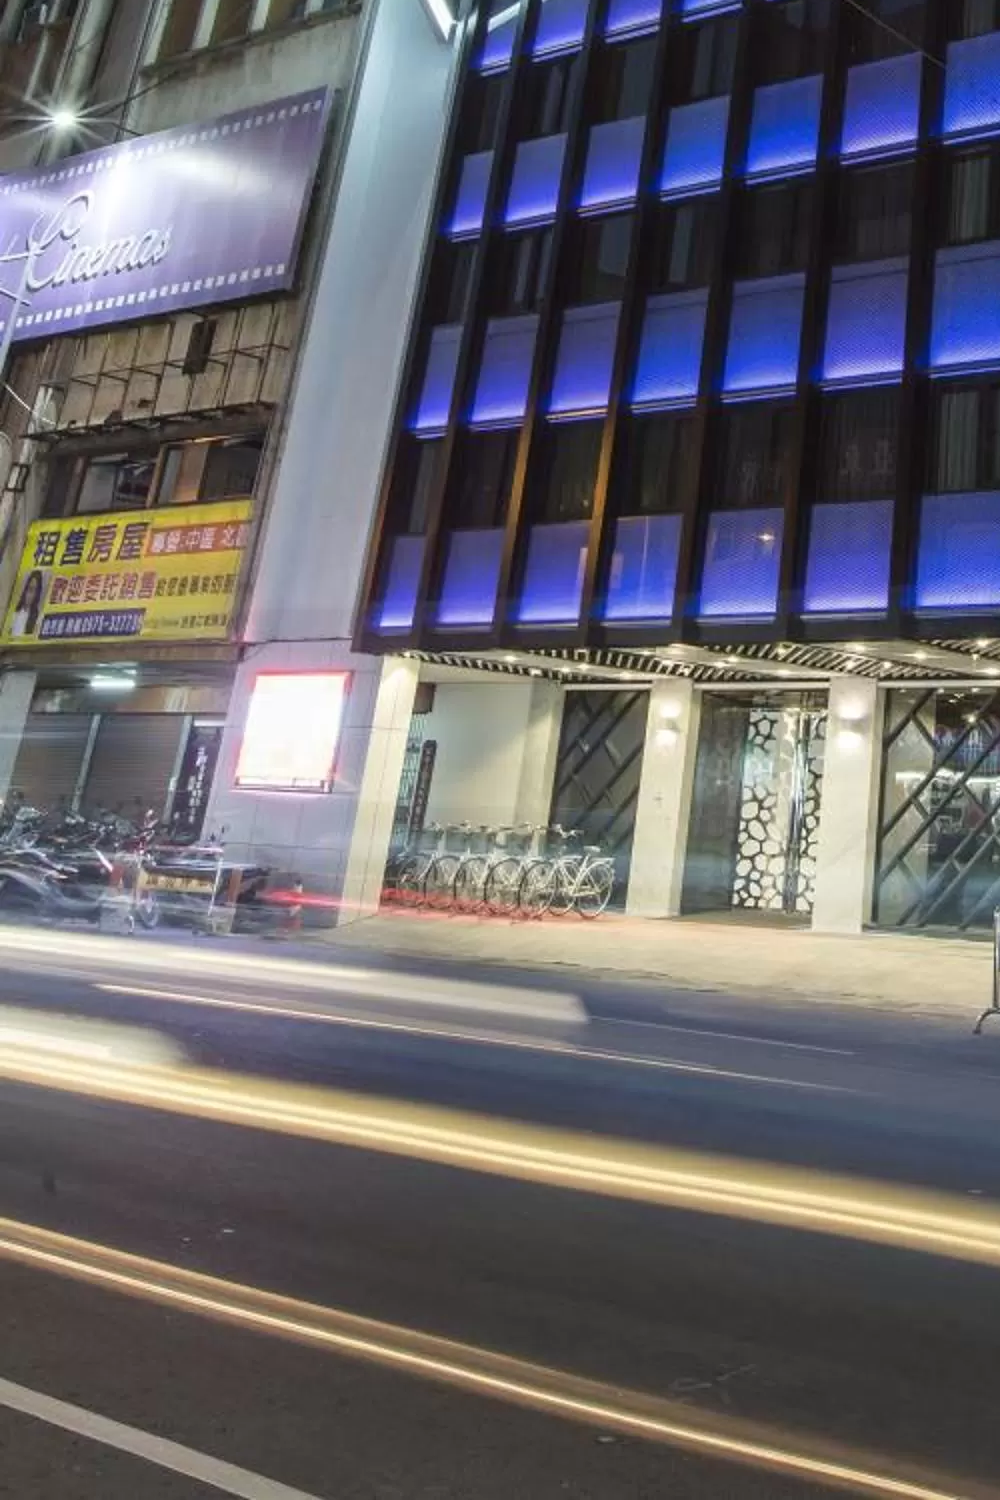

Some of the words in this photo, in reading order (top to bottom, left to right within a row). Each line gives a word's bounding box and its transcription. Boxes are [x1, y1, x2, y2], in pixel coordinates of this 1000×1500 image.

[25, 189, 173, 292] Cinemas
[33, 522, 150, 567] 租售房屋
